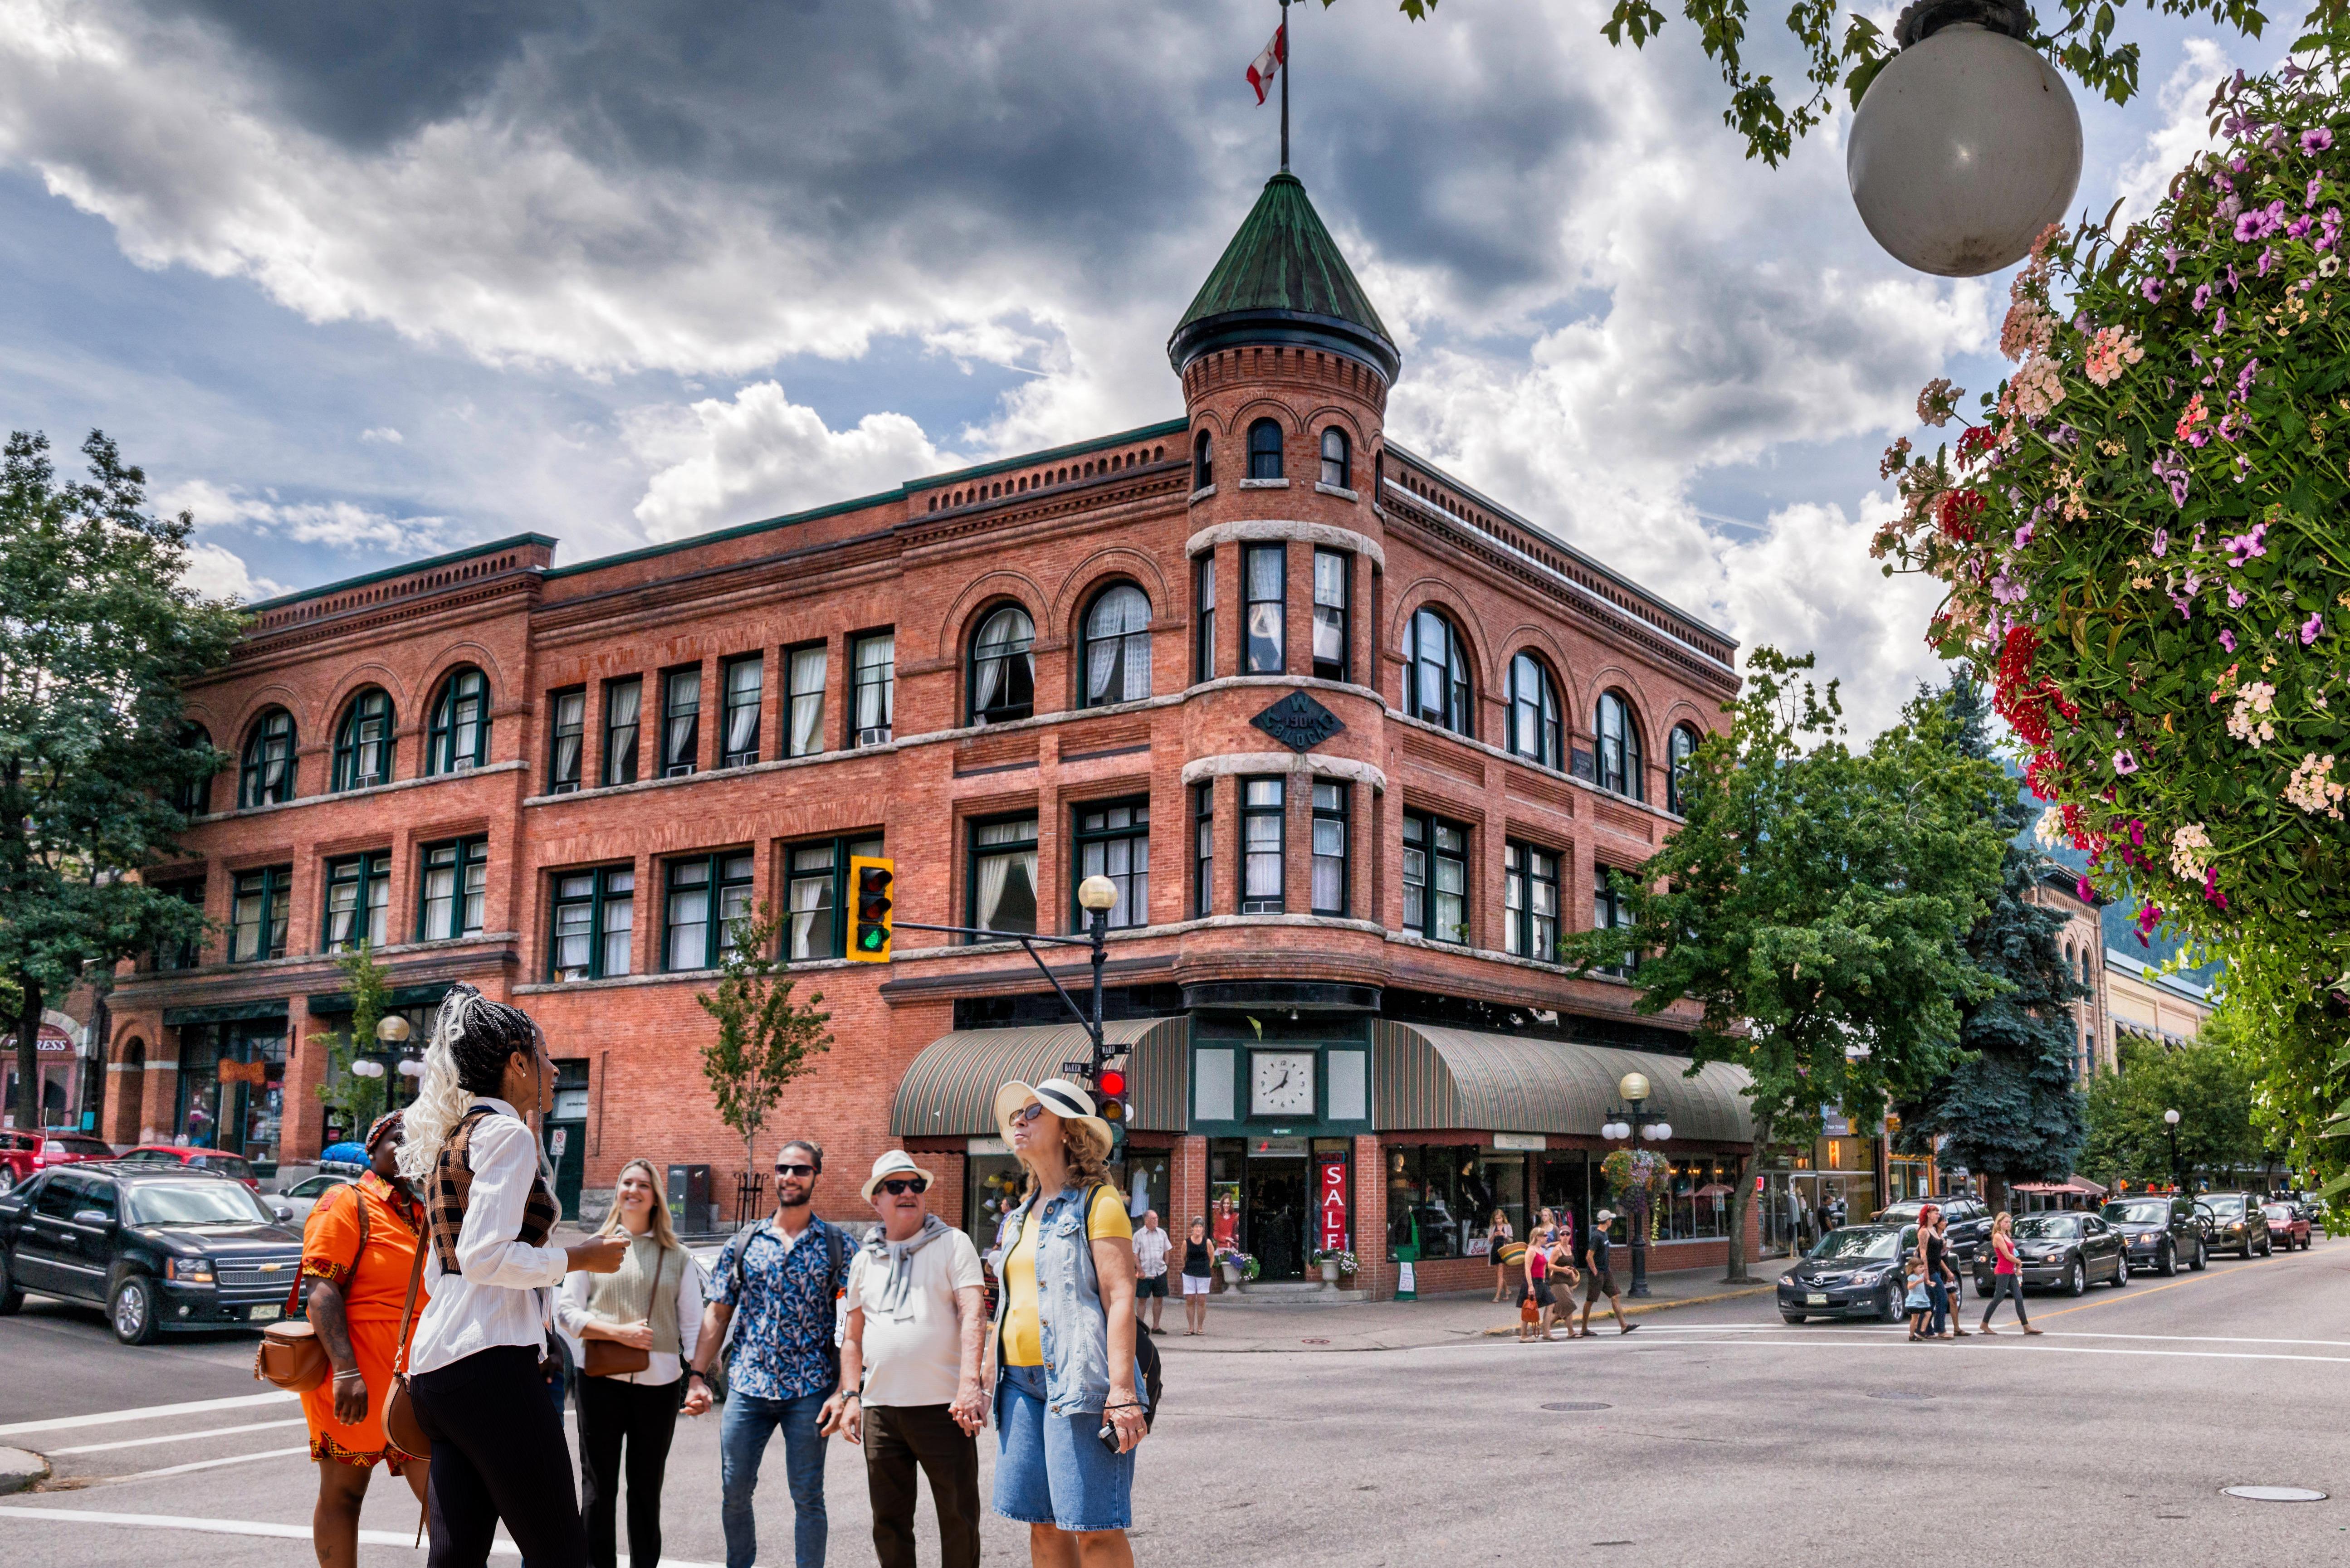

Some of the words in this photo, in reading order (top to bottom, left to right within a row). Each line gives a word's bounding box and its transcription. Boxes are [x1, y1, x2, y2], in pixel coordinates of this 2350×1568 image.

[1273, 724, 1327, 746] BLOCK
[1065, 1064, 1081, 1072] BAKER
[1324, 1167, 1344, 1250] SALE
[1471, 1241, 1487, 1254] Sale
